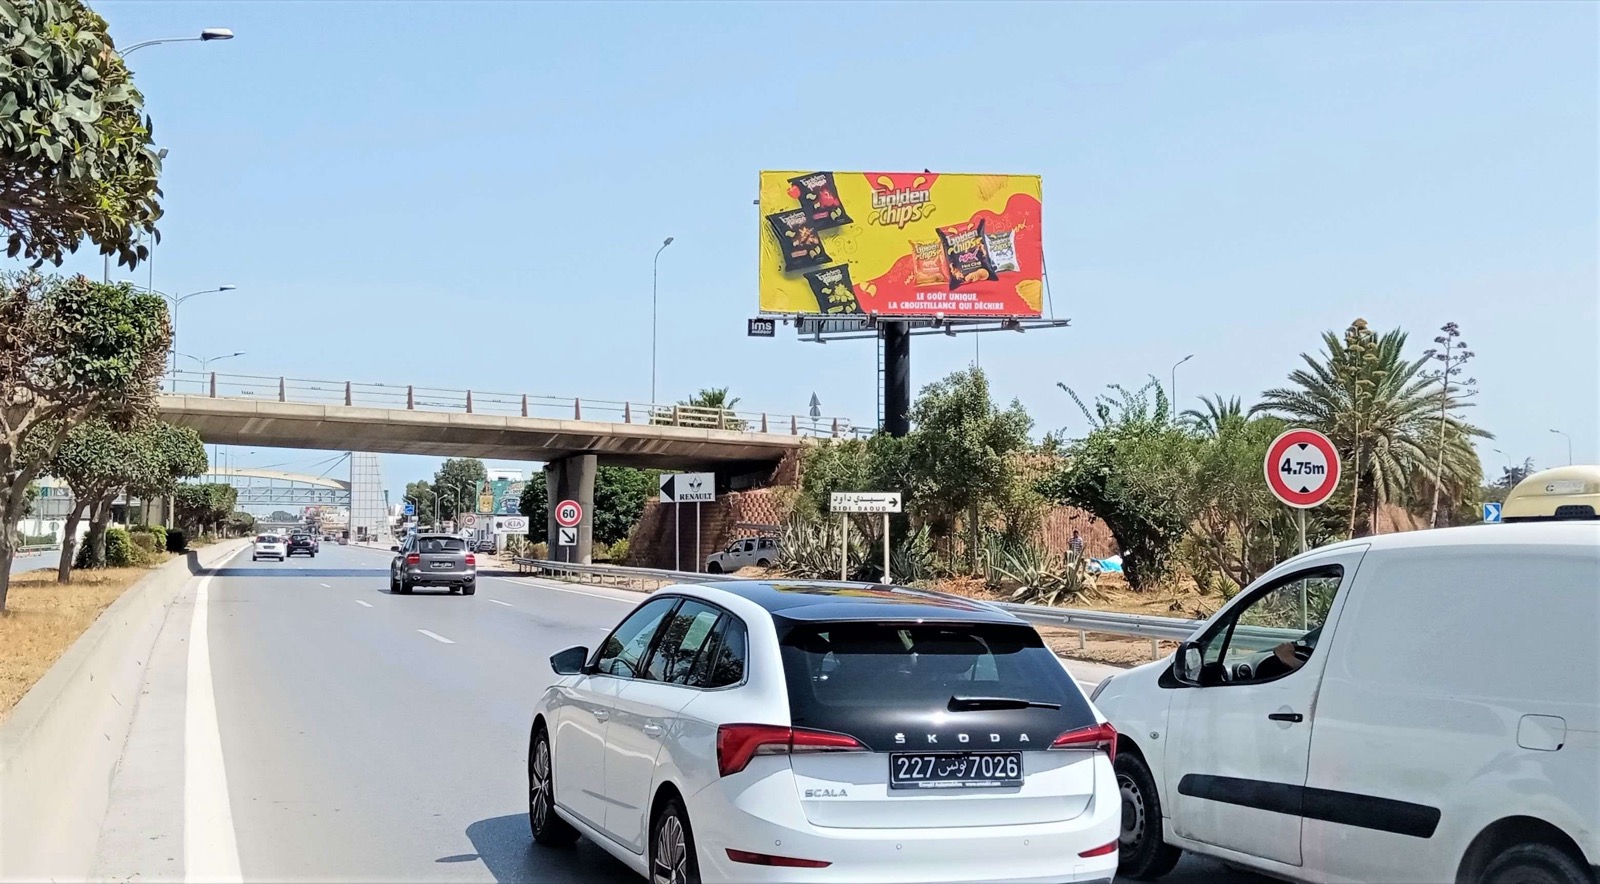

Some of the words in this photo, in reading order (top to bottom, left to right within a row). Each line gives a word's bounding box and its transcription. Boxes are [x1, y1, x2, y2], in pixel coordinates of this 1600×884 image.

[871, 187, 931, 209] Golden
[946, 230, 979, 247] Golden
[916, 293, 925, 301] LE
[926, 291, 947, 300] GOÛT
[888, 301, 898, 309] LA
[900, 301, 957, 310] CROUSTILLANCE
[958, 301, 973, 310] QUI
[974, 301, 1004, 310] DÉCHIRE
[751, 319, 772, 330] ims
[1281, 457, 1325, 475] 4.75m
[562, 509, 575, 519] 60
[895, 733, 1030, 744] ŠKODA
[897, 756, 936, 779] 227
[968, 755, 1018, 778] 7026
[804, 788, 848, 798] SCALA
